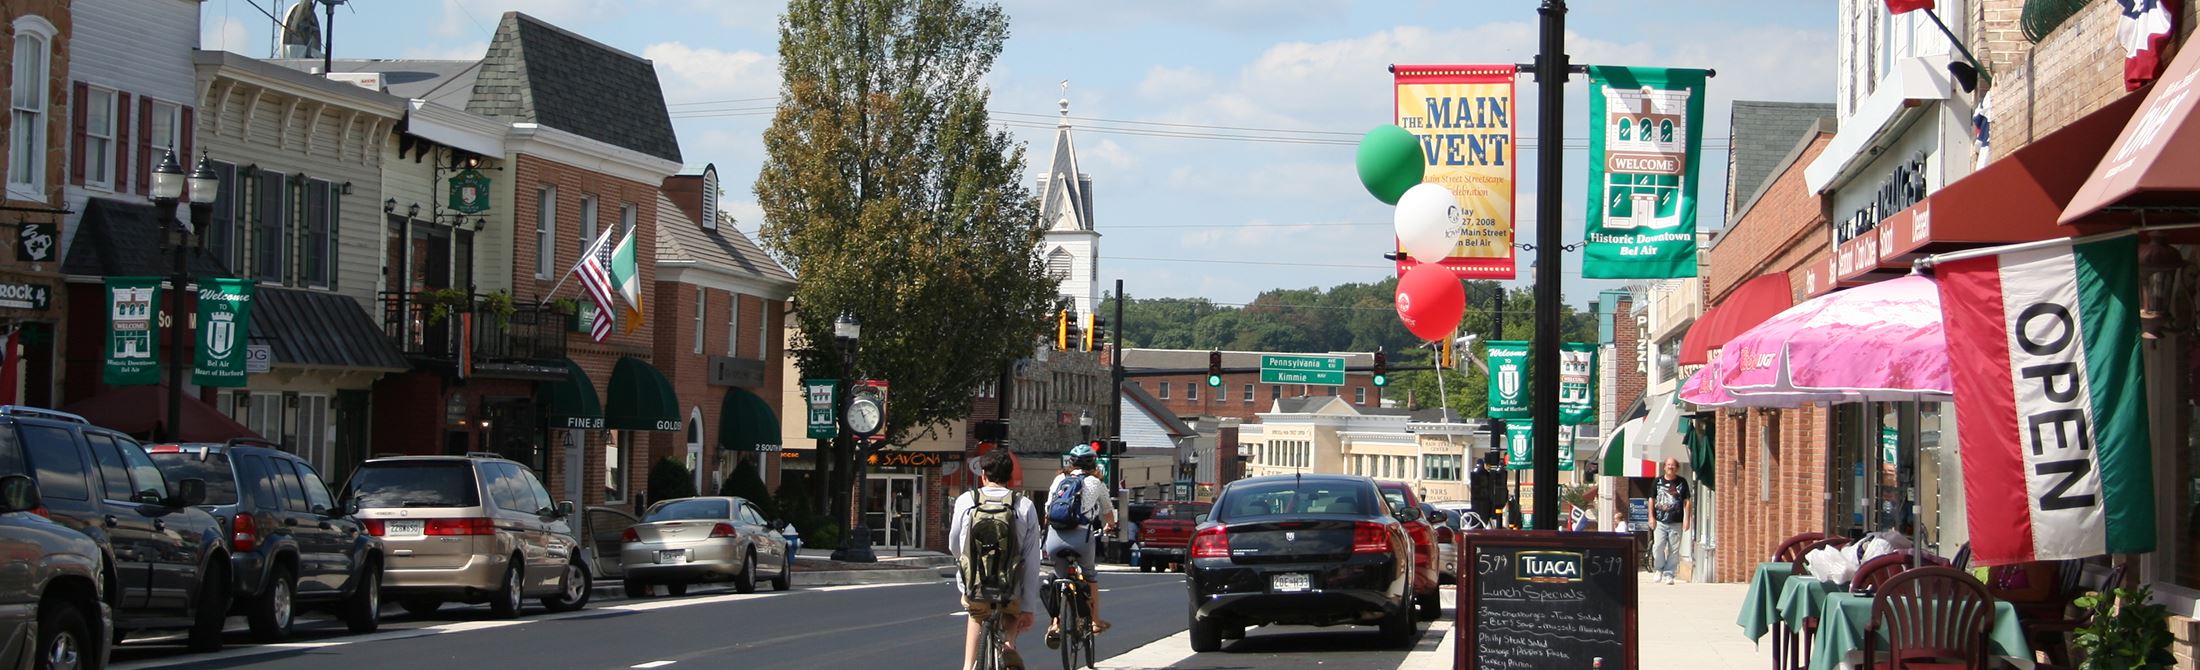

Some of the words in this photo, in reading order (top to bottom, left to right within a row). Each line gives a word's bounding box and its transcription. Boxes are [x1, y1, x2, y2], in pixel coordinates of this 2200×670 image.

[1402, 117, 1423, 128] THE
[1425, 97, 1508, 128] MAIN
[1615, 158, 1674, 170] WELCOME
[1441, 175, 1462, 183] Street
[1462, 218, 1474, 226] 27,
[1477, 218, 1495, 226] 2008
[1482, 229, 1506, 237] Street
[1590, 232, 1633, 244] Historic
[1636, 232, 1691, 243] Downtown
[1465, 239, 1478, 247] Bel
[1479, 239, 1491, 247] Air
[1620, 246, 1638, 255] Bel
[1639, 245, 1658, 255] Air
[200, 289, 250, 301] Welcome
[116, 322, 145, 330] WELCOME
[1637, 315, 1647, 373] PIZZA
[1488, 348, 1527, 357] Welcome
[1269, 357, 1320, 368] Pennsylvania
[195, 368, 210, 376] Heart
[1278, 372, 1307, 381] Kimmie
[2016, 303, 2095, 511] OPEN
[568, 417, 591, 429] FINE
[1479, 555, 1508, 575] 5.99
[1522, 556, 1576, 574] TUACA
[1590, 556, 1622, 576] 5.99
[1482, 582, 1521, 597] Lunch
[1522, 585, 1586, 600] Specials
[1479, 632, 1501, 645] Philly
